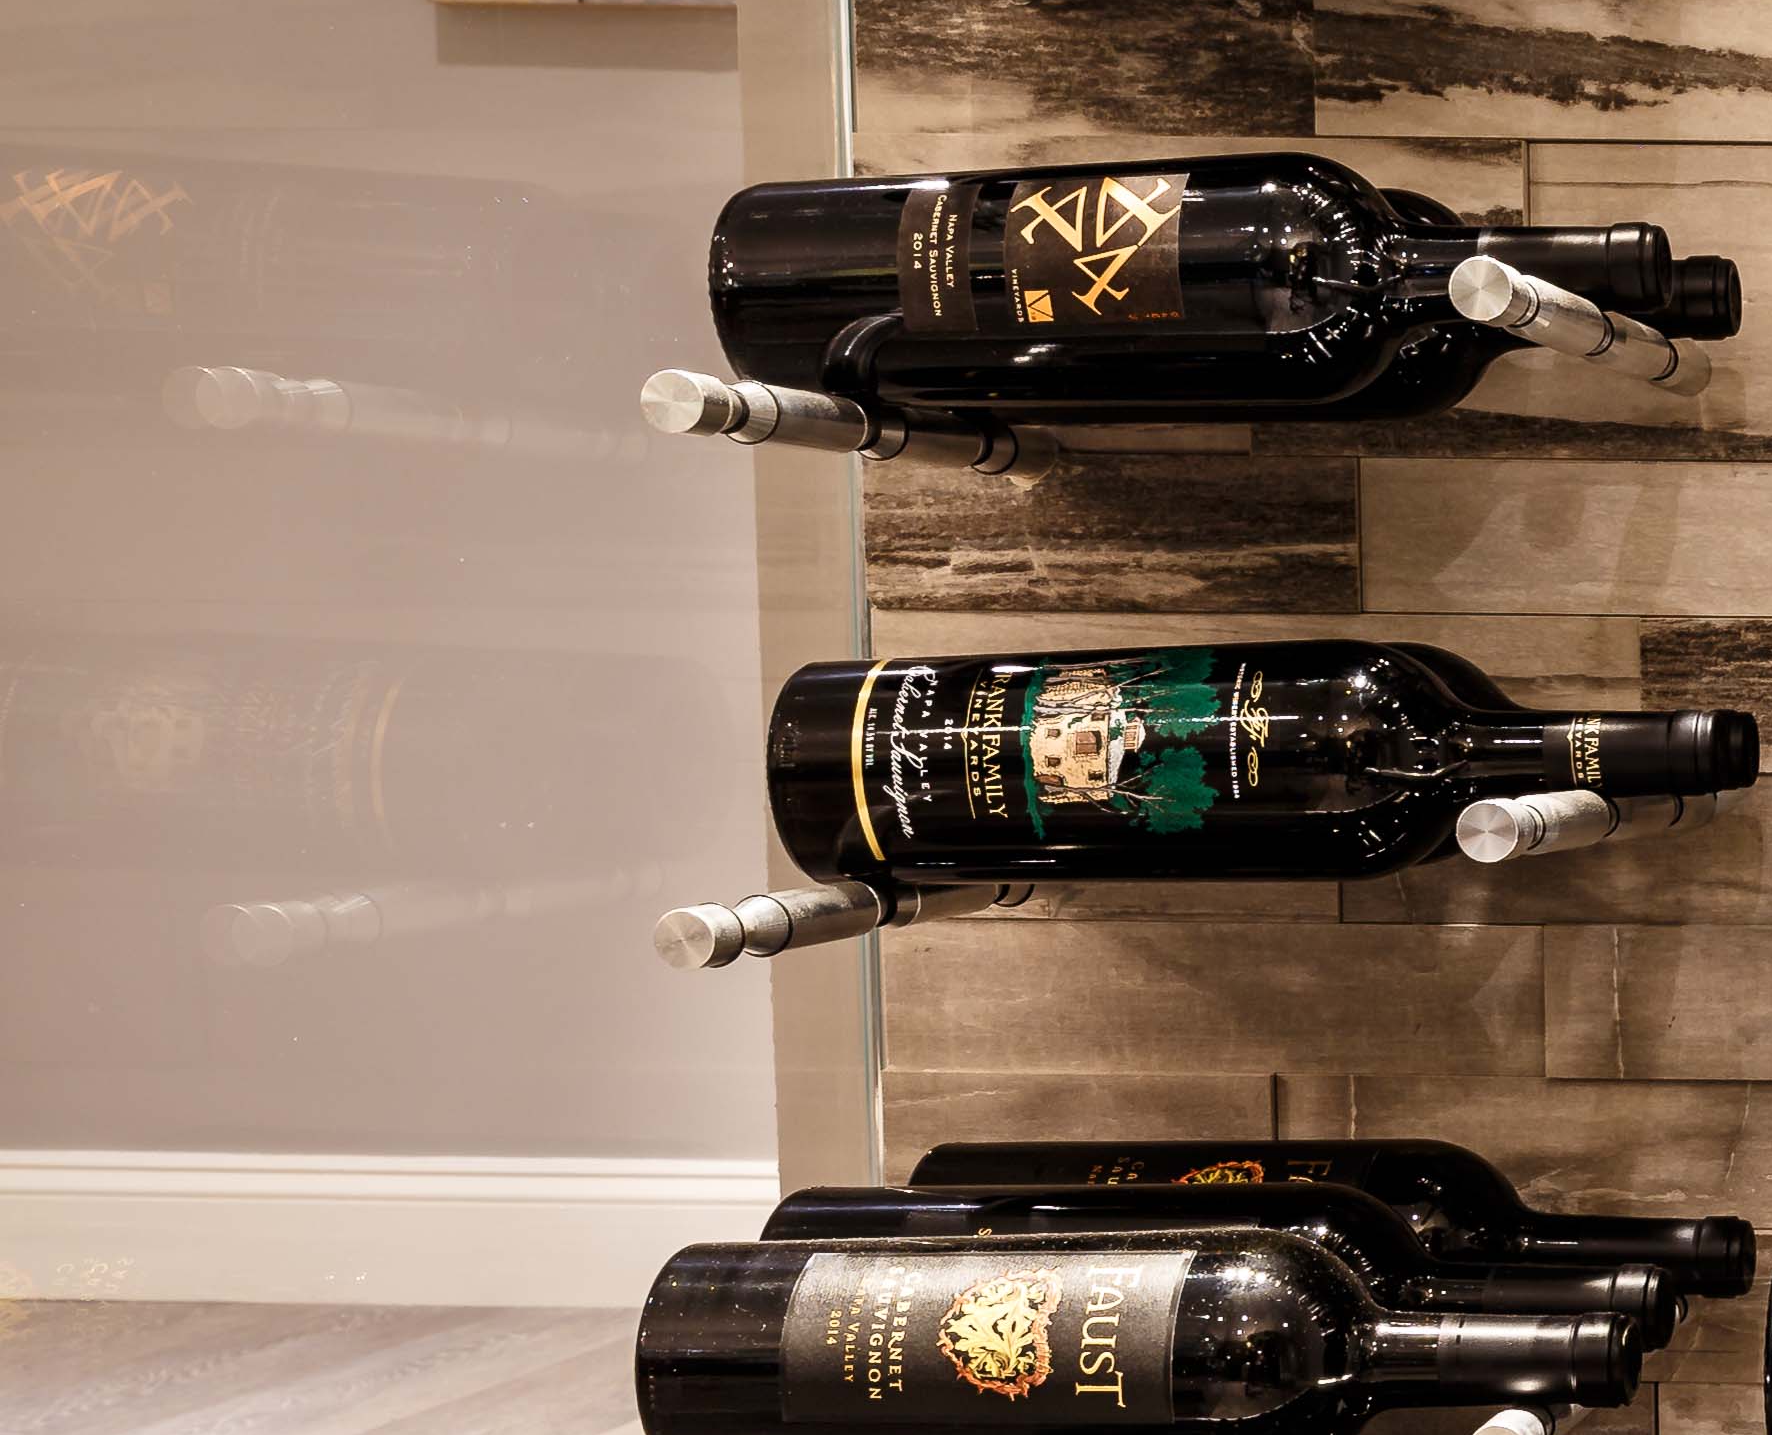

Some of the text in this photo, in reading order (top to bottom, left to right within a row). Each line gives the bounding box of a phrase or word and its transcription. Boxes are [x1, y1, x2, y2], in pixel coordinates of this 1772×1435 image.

[913, 233, 923, 270] 2014
[929, 195, 947, 317] CABERNET SAUVIGNON
[945, 214, 957, 288] NAPA VALLEY
[882, 734, 923, 838] Sauvignon
[919, 680, 938, 802] NAPA VALLEY
[944, 718, 954, 750] 2014
[971, 681, 988, 797] VINEYARDS
[983, 734, 1008, 819] FAMILY
[826, 1310, 842, 1345] 2014
[844, 1322, 860, 1382] VALLEY
[868, 1266, 906, 1400] SAUVIGNON
[888, 1272, 918, 1391] CABERNET
[1075, 1264, 1141, 1408] FAUST
